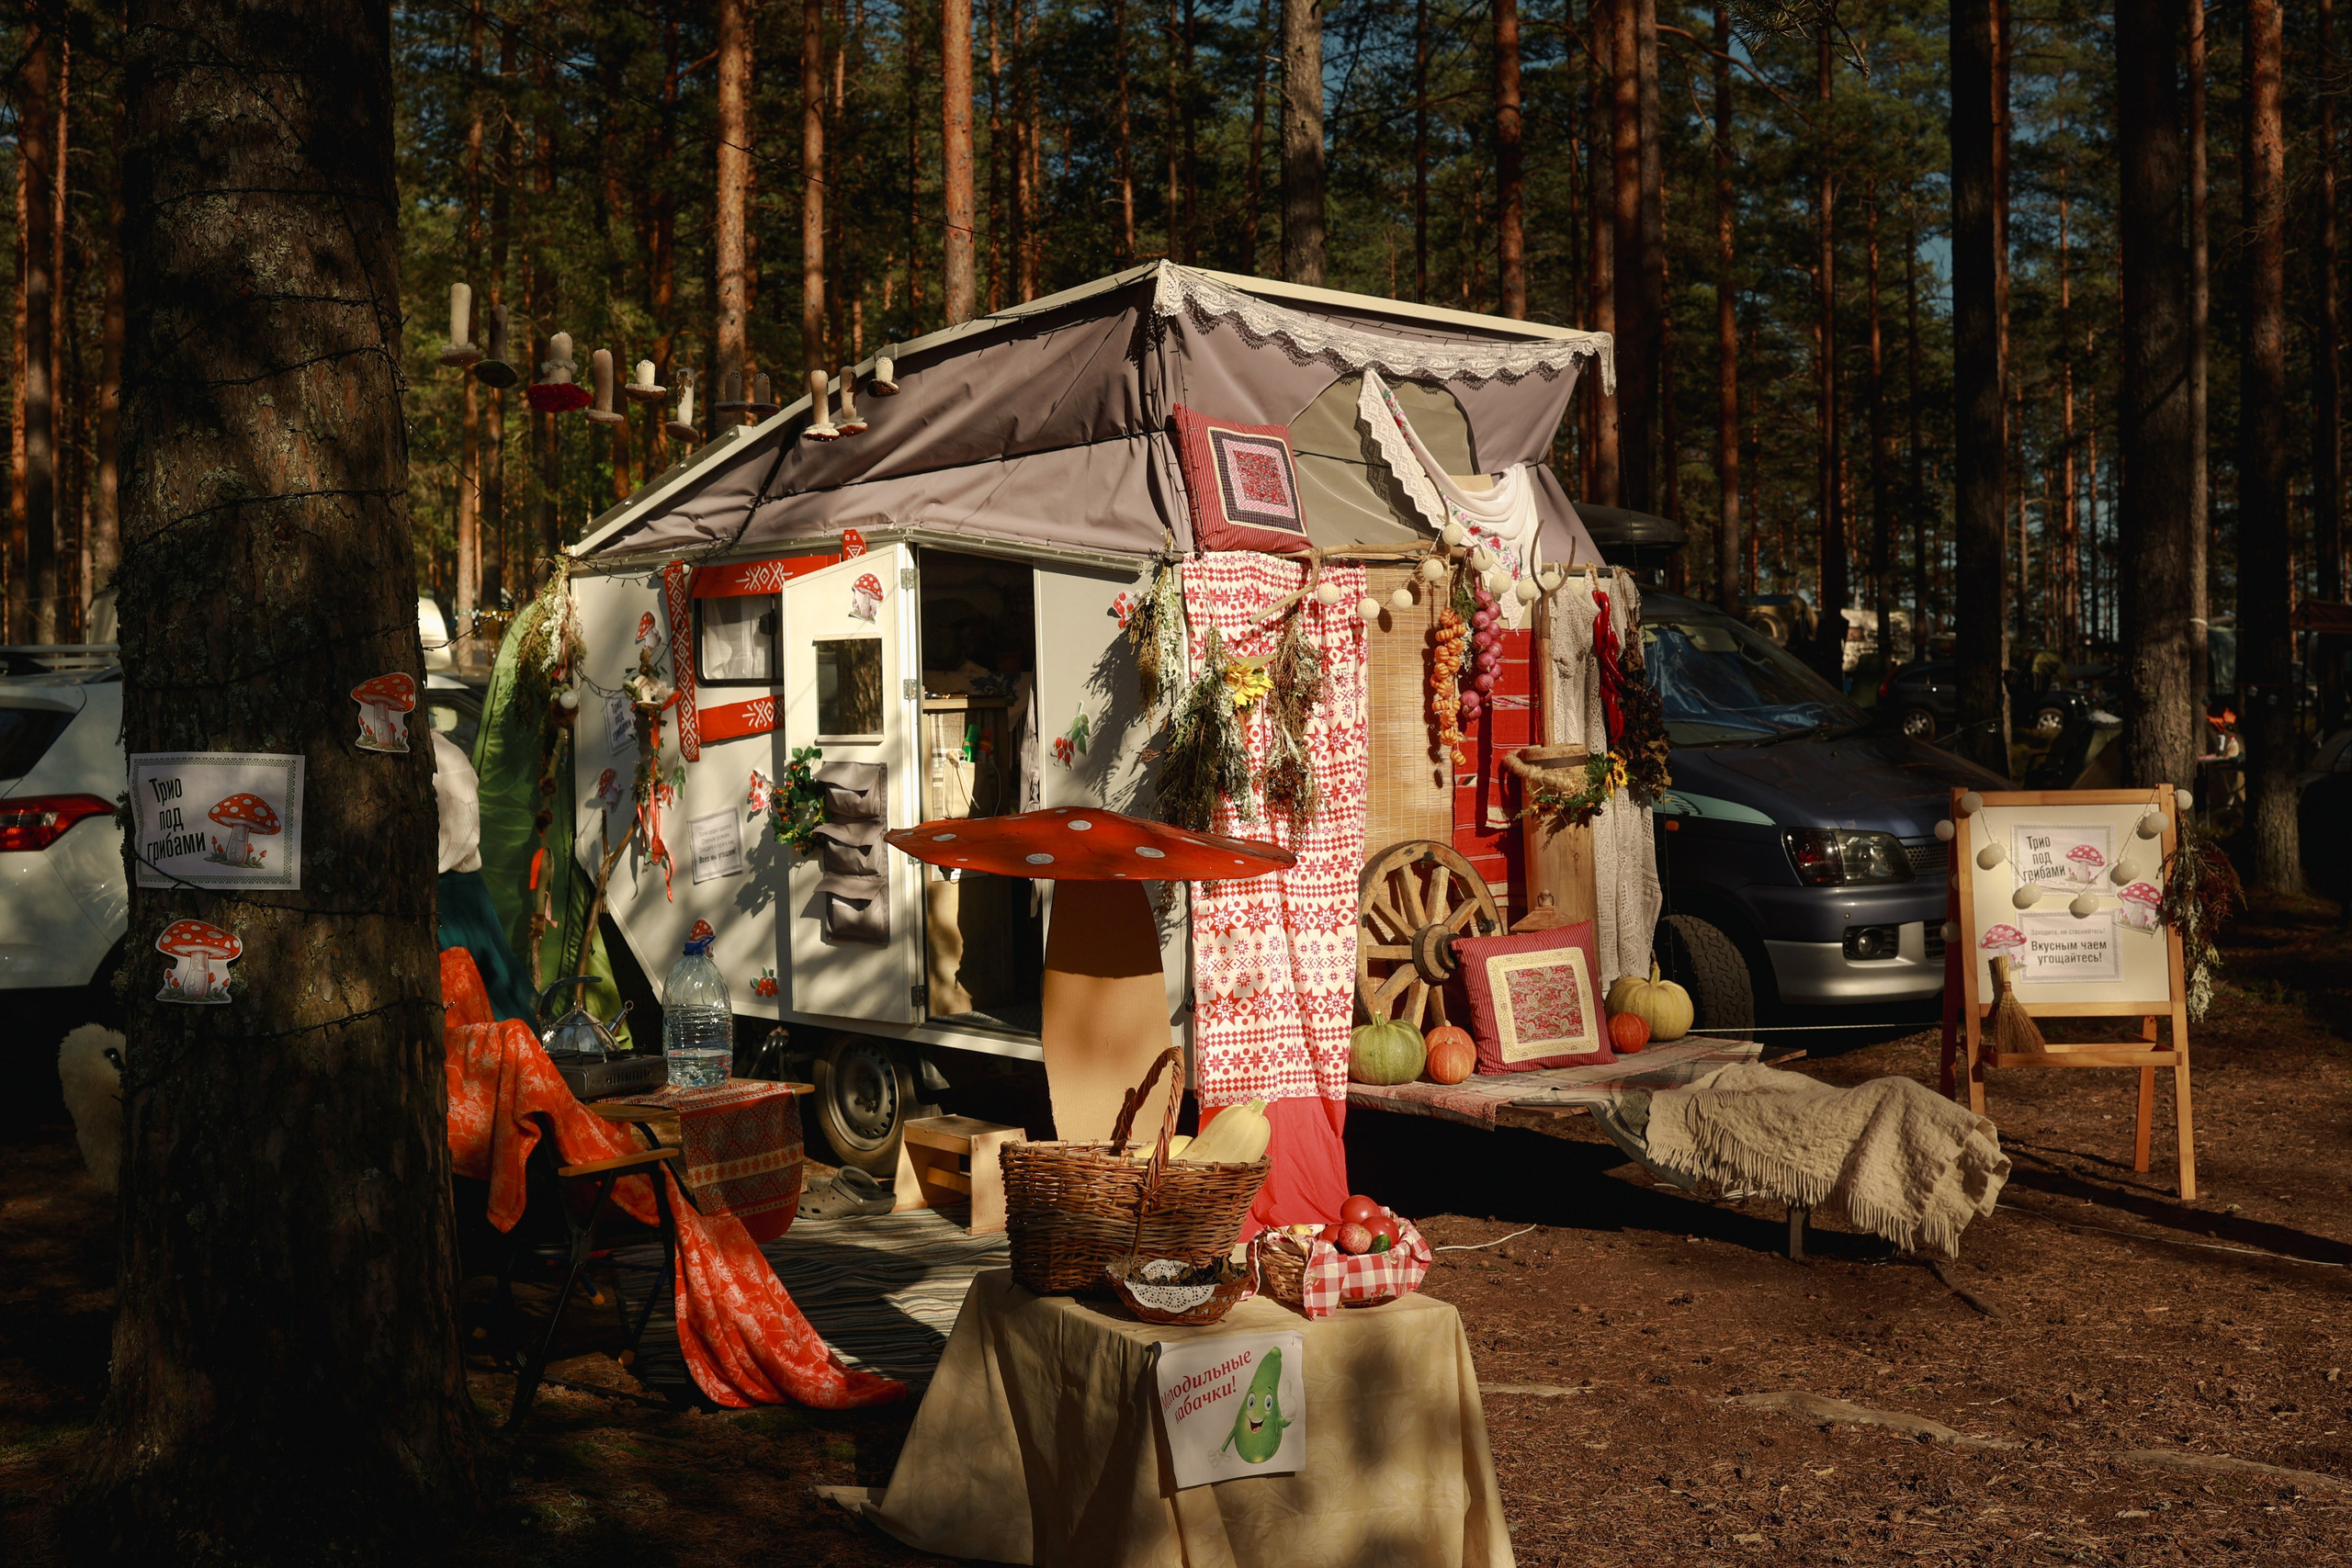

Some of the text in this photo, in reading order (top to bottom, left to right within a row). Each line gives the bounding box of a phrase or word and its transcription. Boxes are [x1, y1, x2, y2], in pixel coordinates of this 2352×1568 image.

[149, 778, 183, 807] Трио
[159, 807, 184, 832] под
[147, 831, 206, 866] грибами
[2027, 836, 2051, 852] Трио
[2032, 852, 2052, 865] под
[2023, 864, 2066, 884] грибами
[2031, 940, 2107, 953] Вкусным чаем
[2037, 952, 2102, 965] угощайтесь!
[1160, 1350, 1252, 1414] Молодильные
[1174, 1375, 1237, 1425] кабачки!
